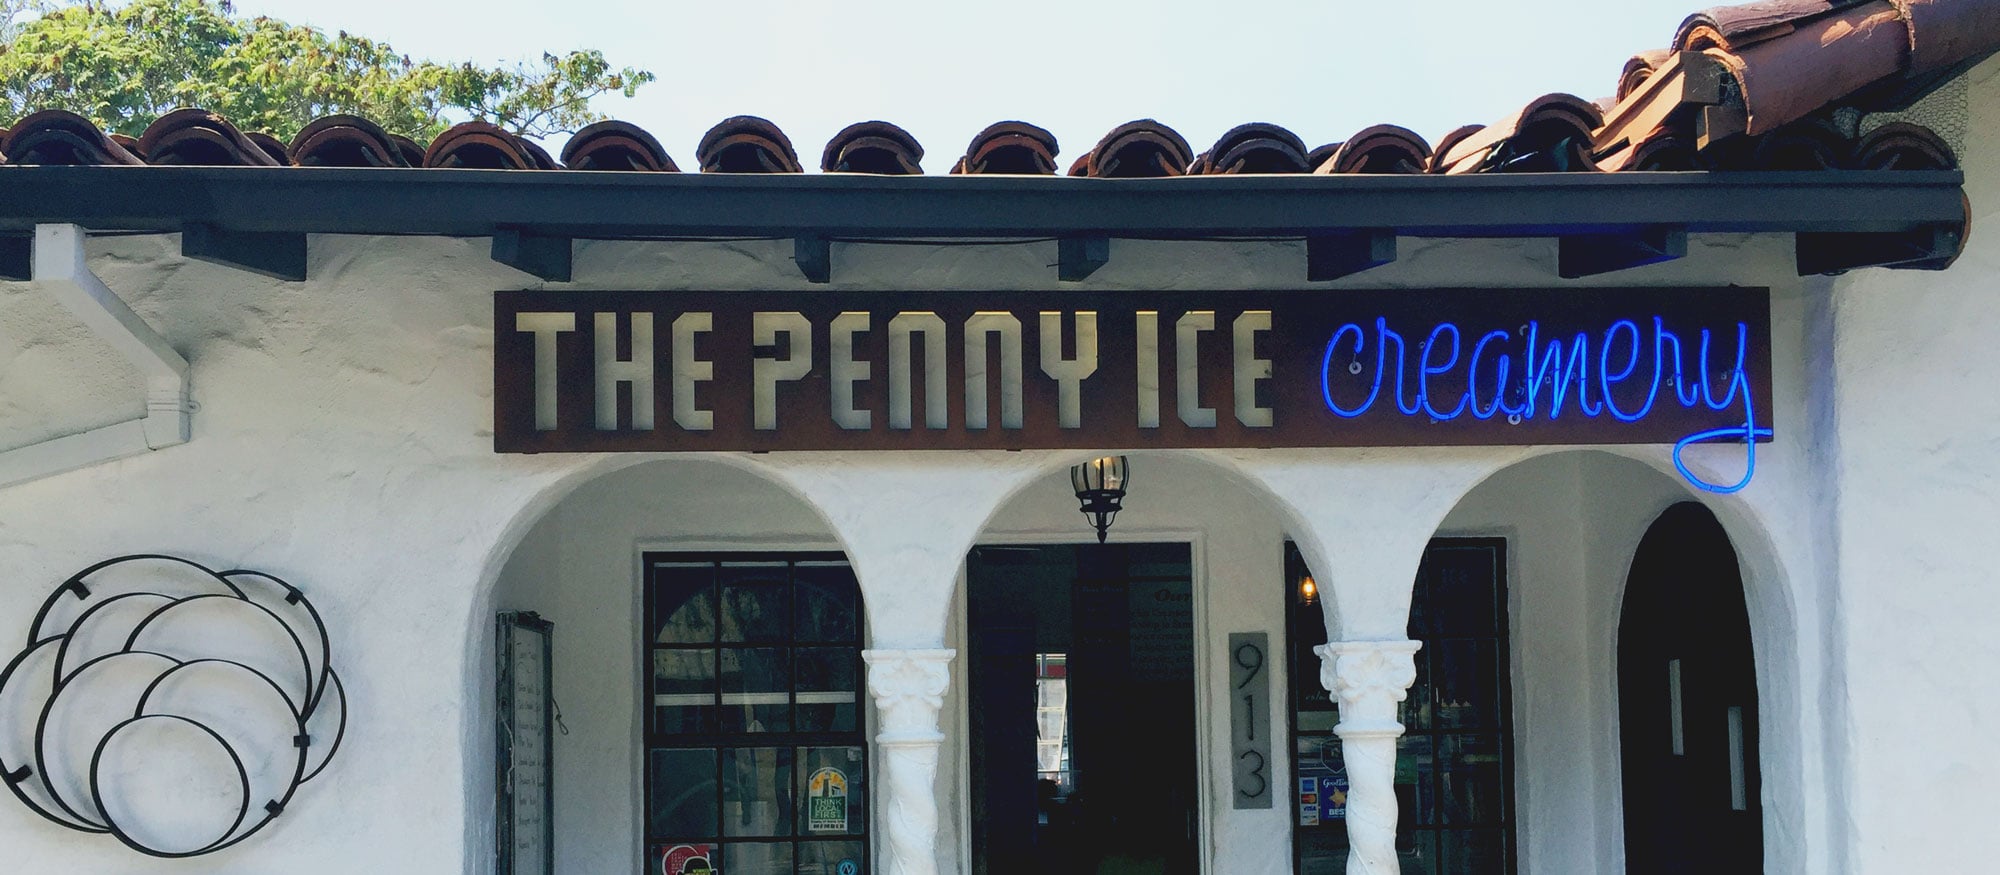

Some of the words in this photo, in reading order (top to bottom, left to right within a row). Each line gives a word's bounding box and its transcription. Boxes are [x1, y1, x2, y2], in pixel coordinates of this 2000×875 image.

[515, 311, 714, 430] THE
[753, 310, 1099, 430] PENNY
[1136, 310, 1274, 429] ICE
[1321, 316, 1773, 494] creamery
[1235, 644, 1266, 798] 913
[815, 798, 842, 806] THINK
[1328, 808, 1346, 816] BES
